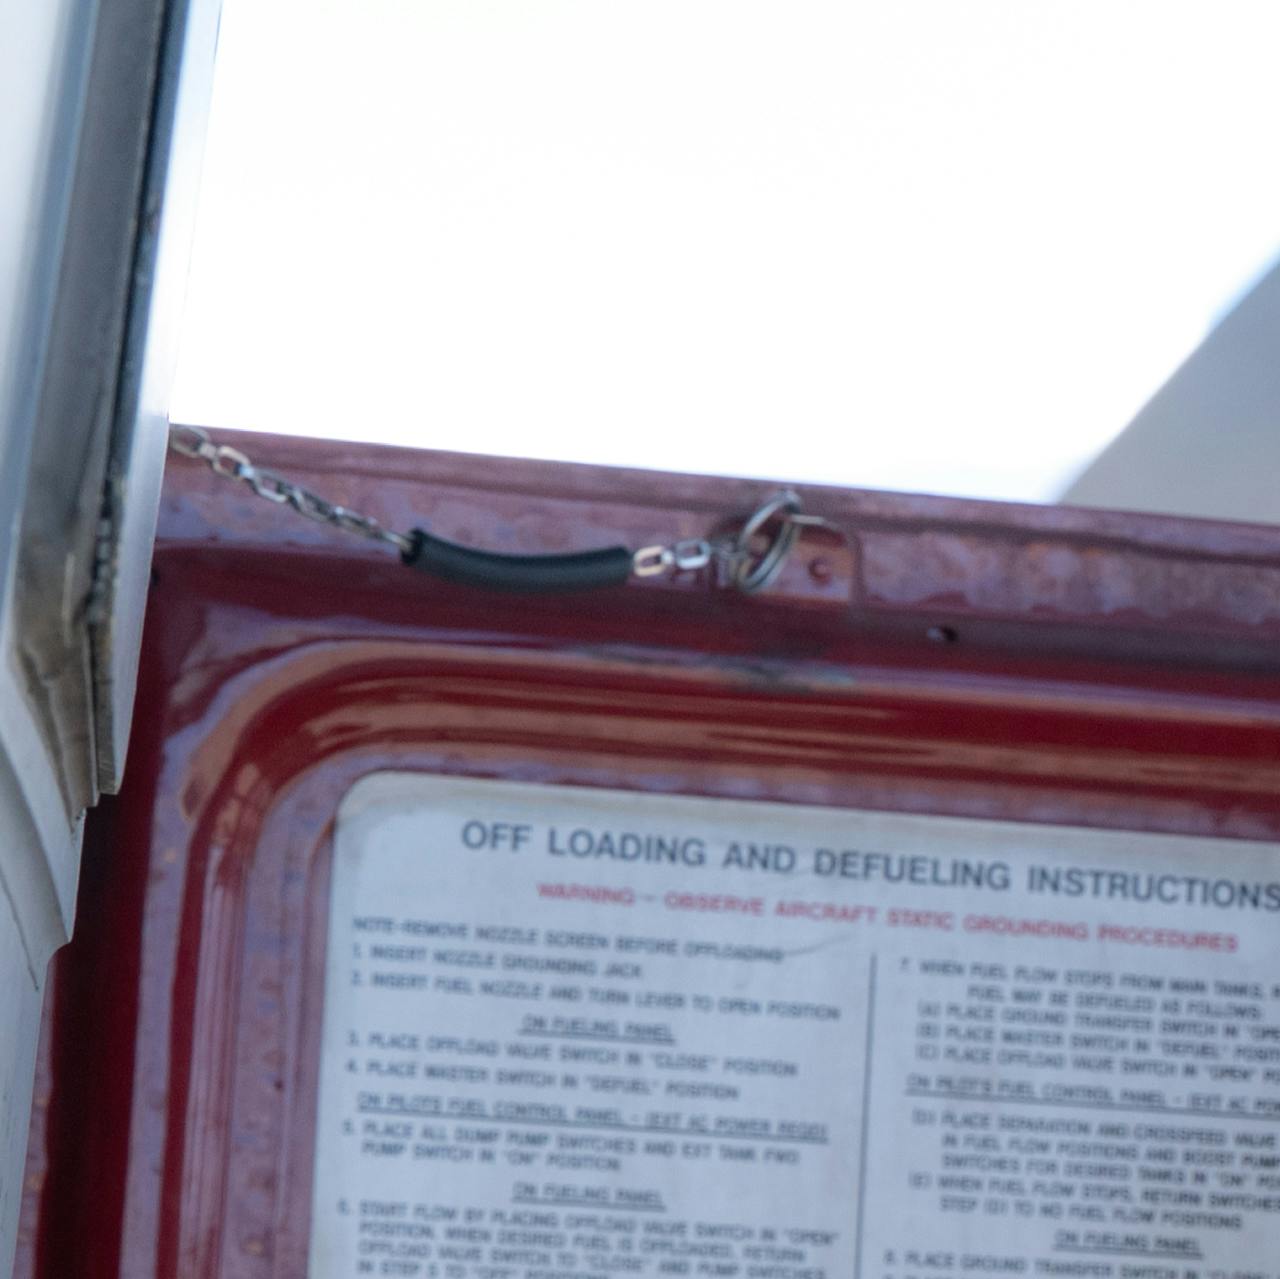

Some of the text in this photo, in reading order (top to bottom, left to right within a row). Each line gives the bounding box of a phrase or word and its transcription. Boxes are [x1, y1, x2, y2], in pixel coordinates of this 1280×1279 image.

[461, 818, 531, 852] OFF
[546, 825, 706, 866] LOADING
[723, 840, 796, 874] AND
[813, 847, 1011, 891] DEFUELING
[537, 880, 1238, 952] WARNING OBSERVE AIRCRAFT STATIC GROUNDING PROCEDURES
